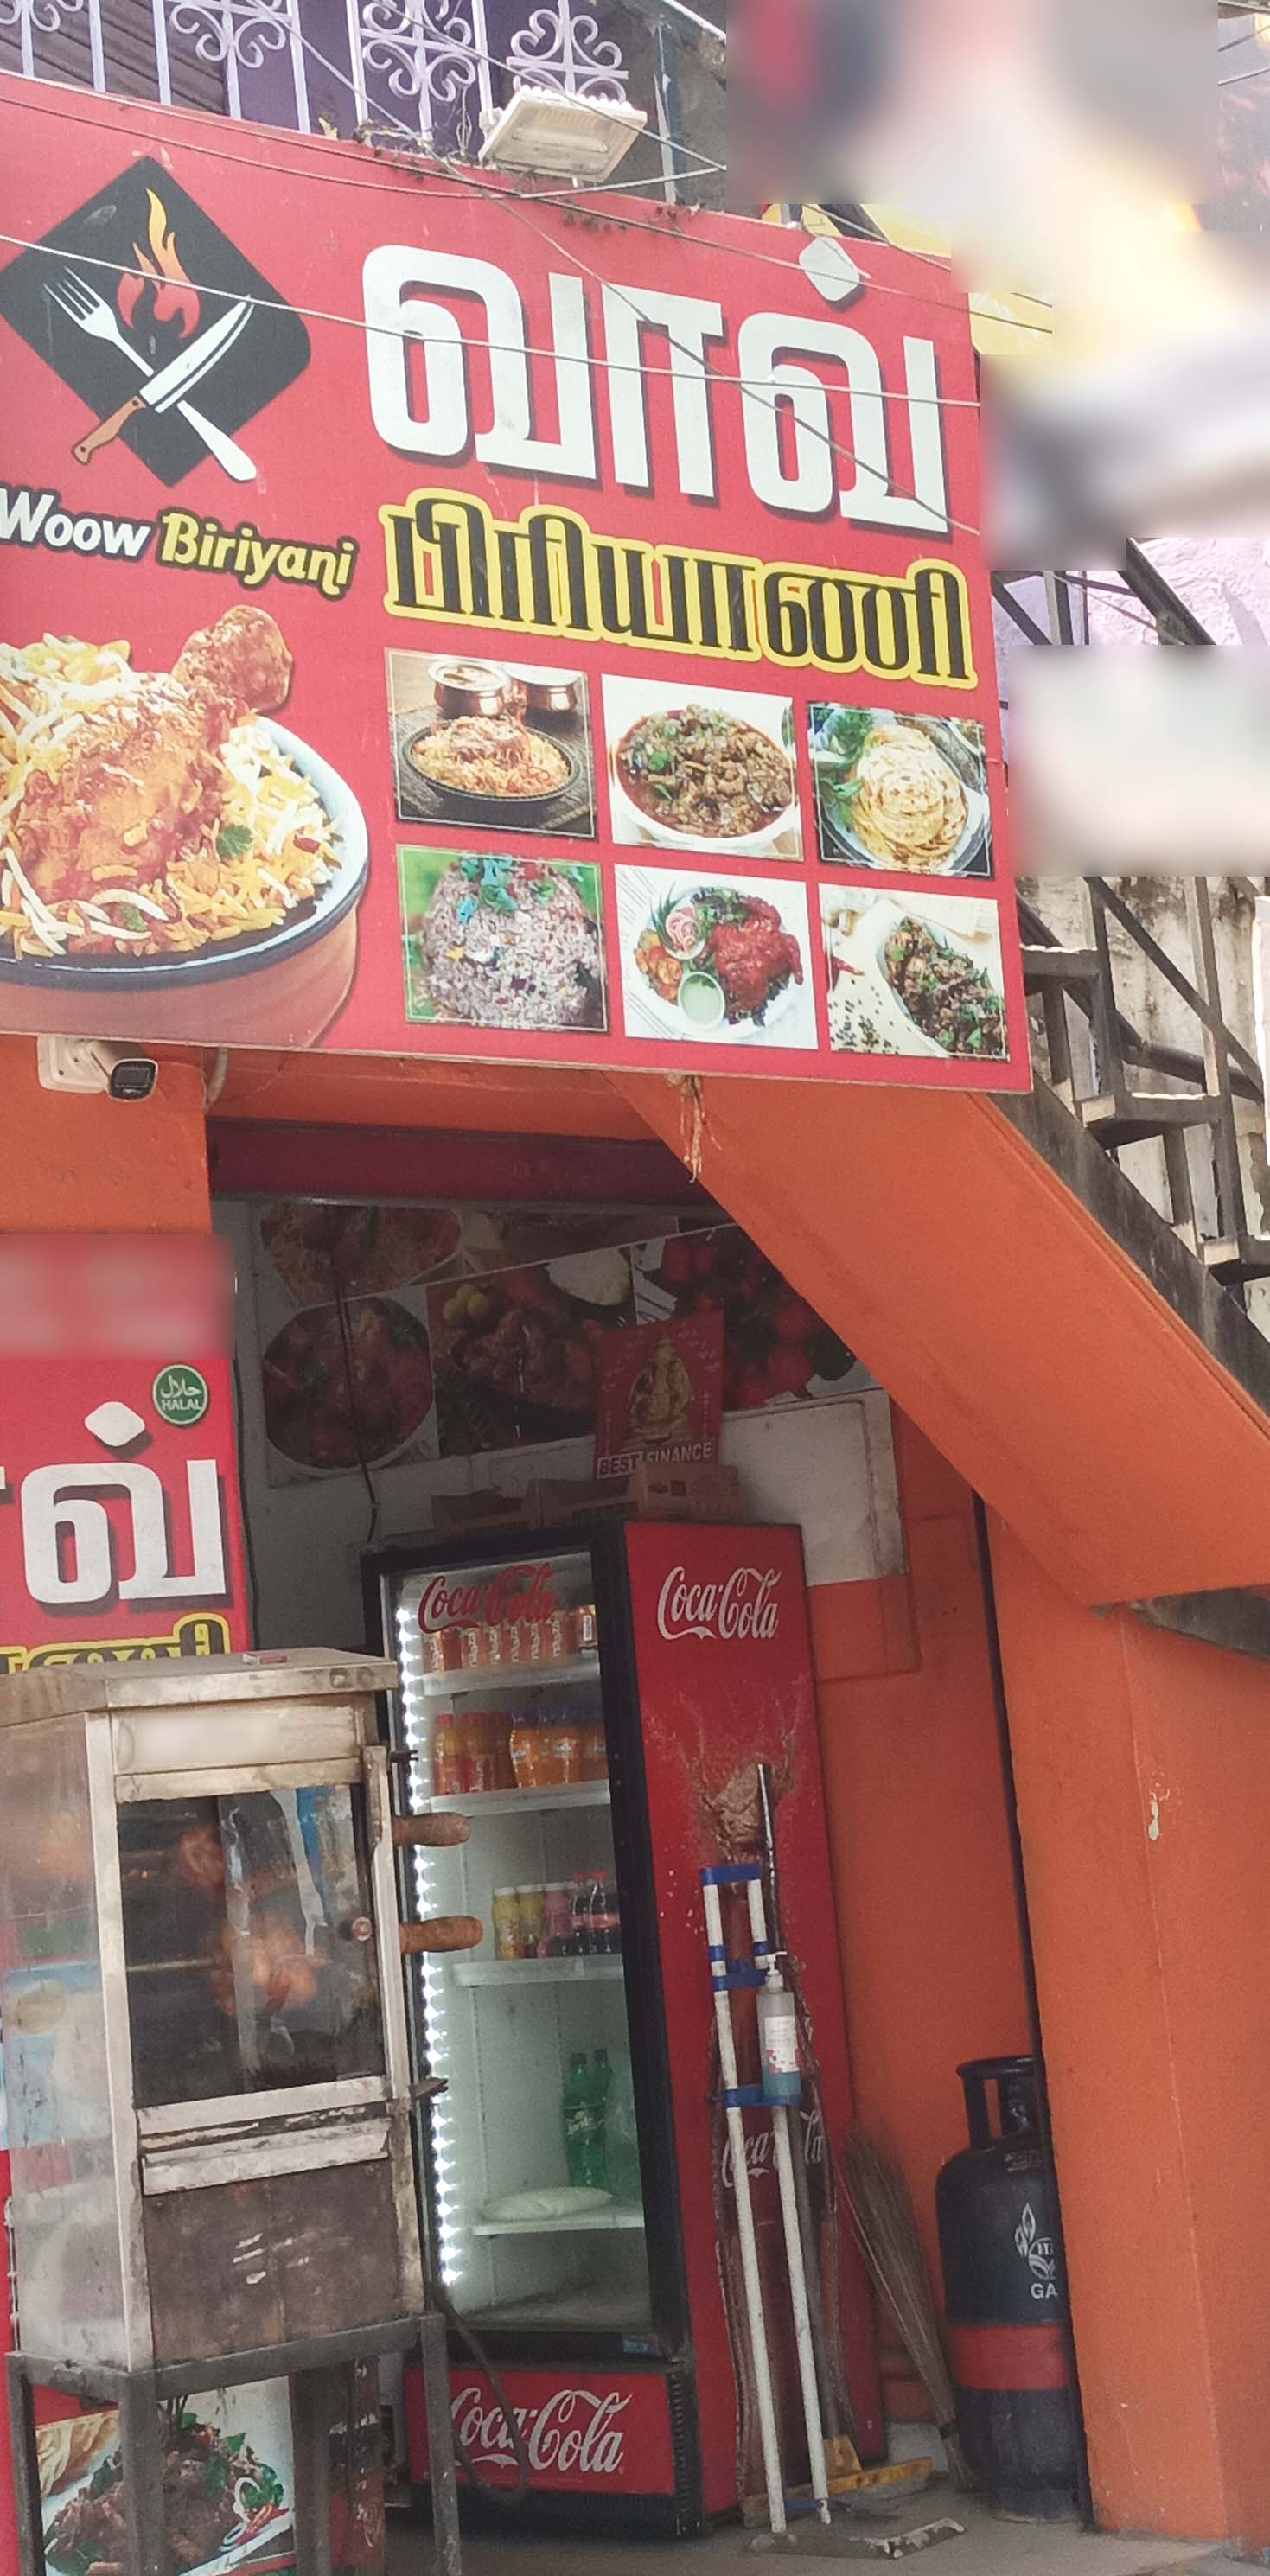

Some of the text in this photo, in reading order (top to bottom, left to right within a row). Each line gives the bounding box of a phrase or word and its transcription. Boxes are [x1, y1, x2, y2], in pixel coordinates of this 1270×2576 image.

[361, 236, 948, 533] வாவ்
[0, 488, 355, 596] Woow Biriyani
[386, 497, 973, 681] பிரியாணி
[160, 1374, 201, 1398] حلال
[161, 1396, 203, 1412] HALAL
[600, 1441, 712, 1476] BEST FINANCE
[418, 1562, 555, 1635] Coca-Cola
[657, 1565, 782, 1641] Coca-Cola
